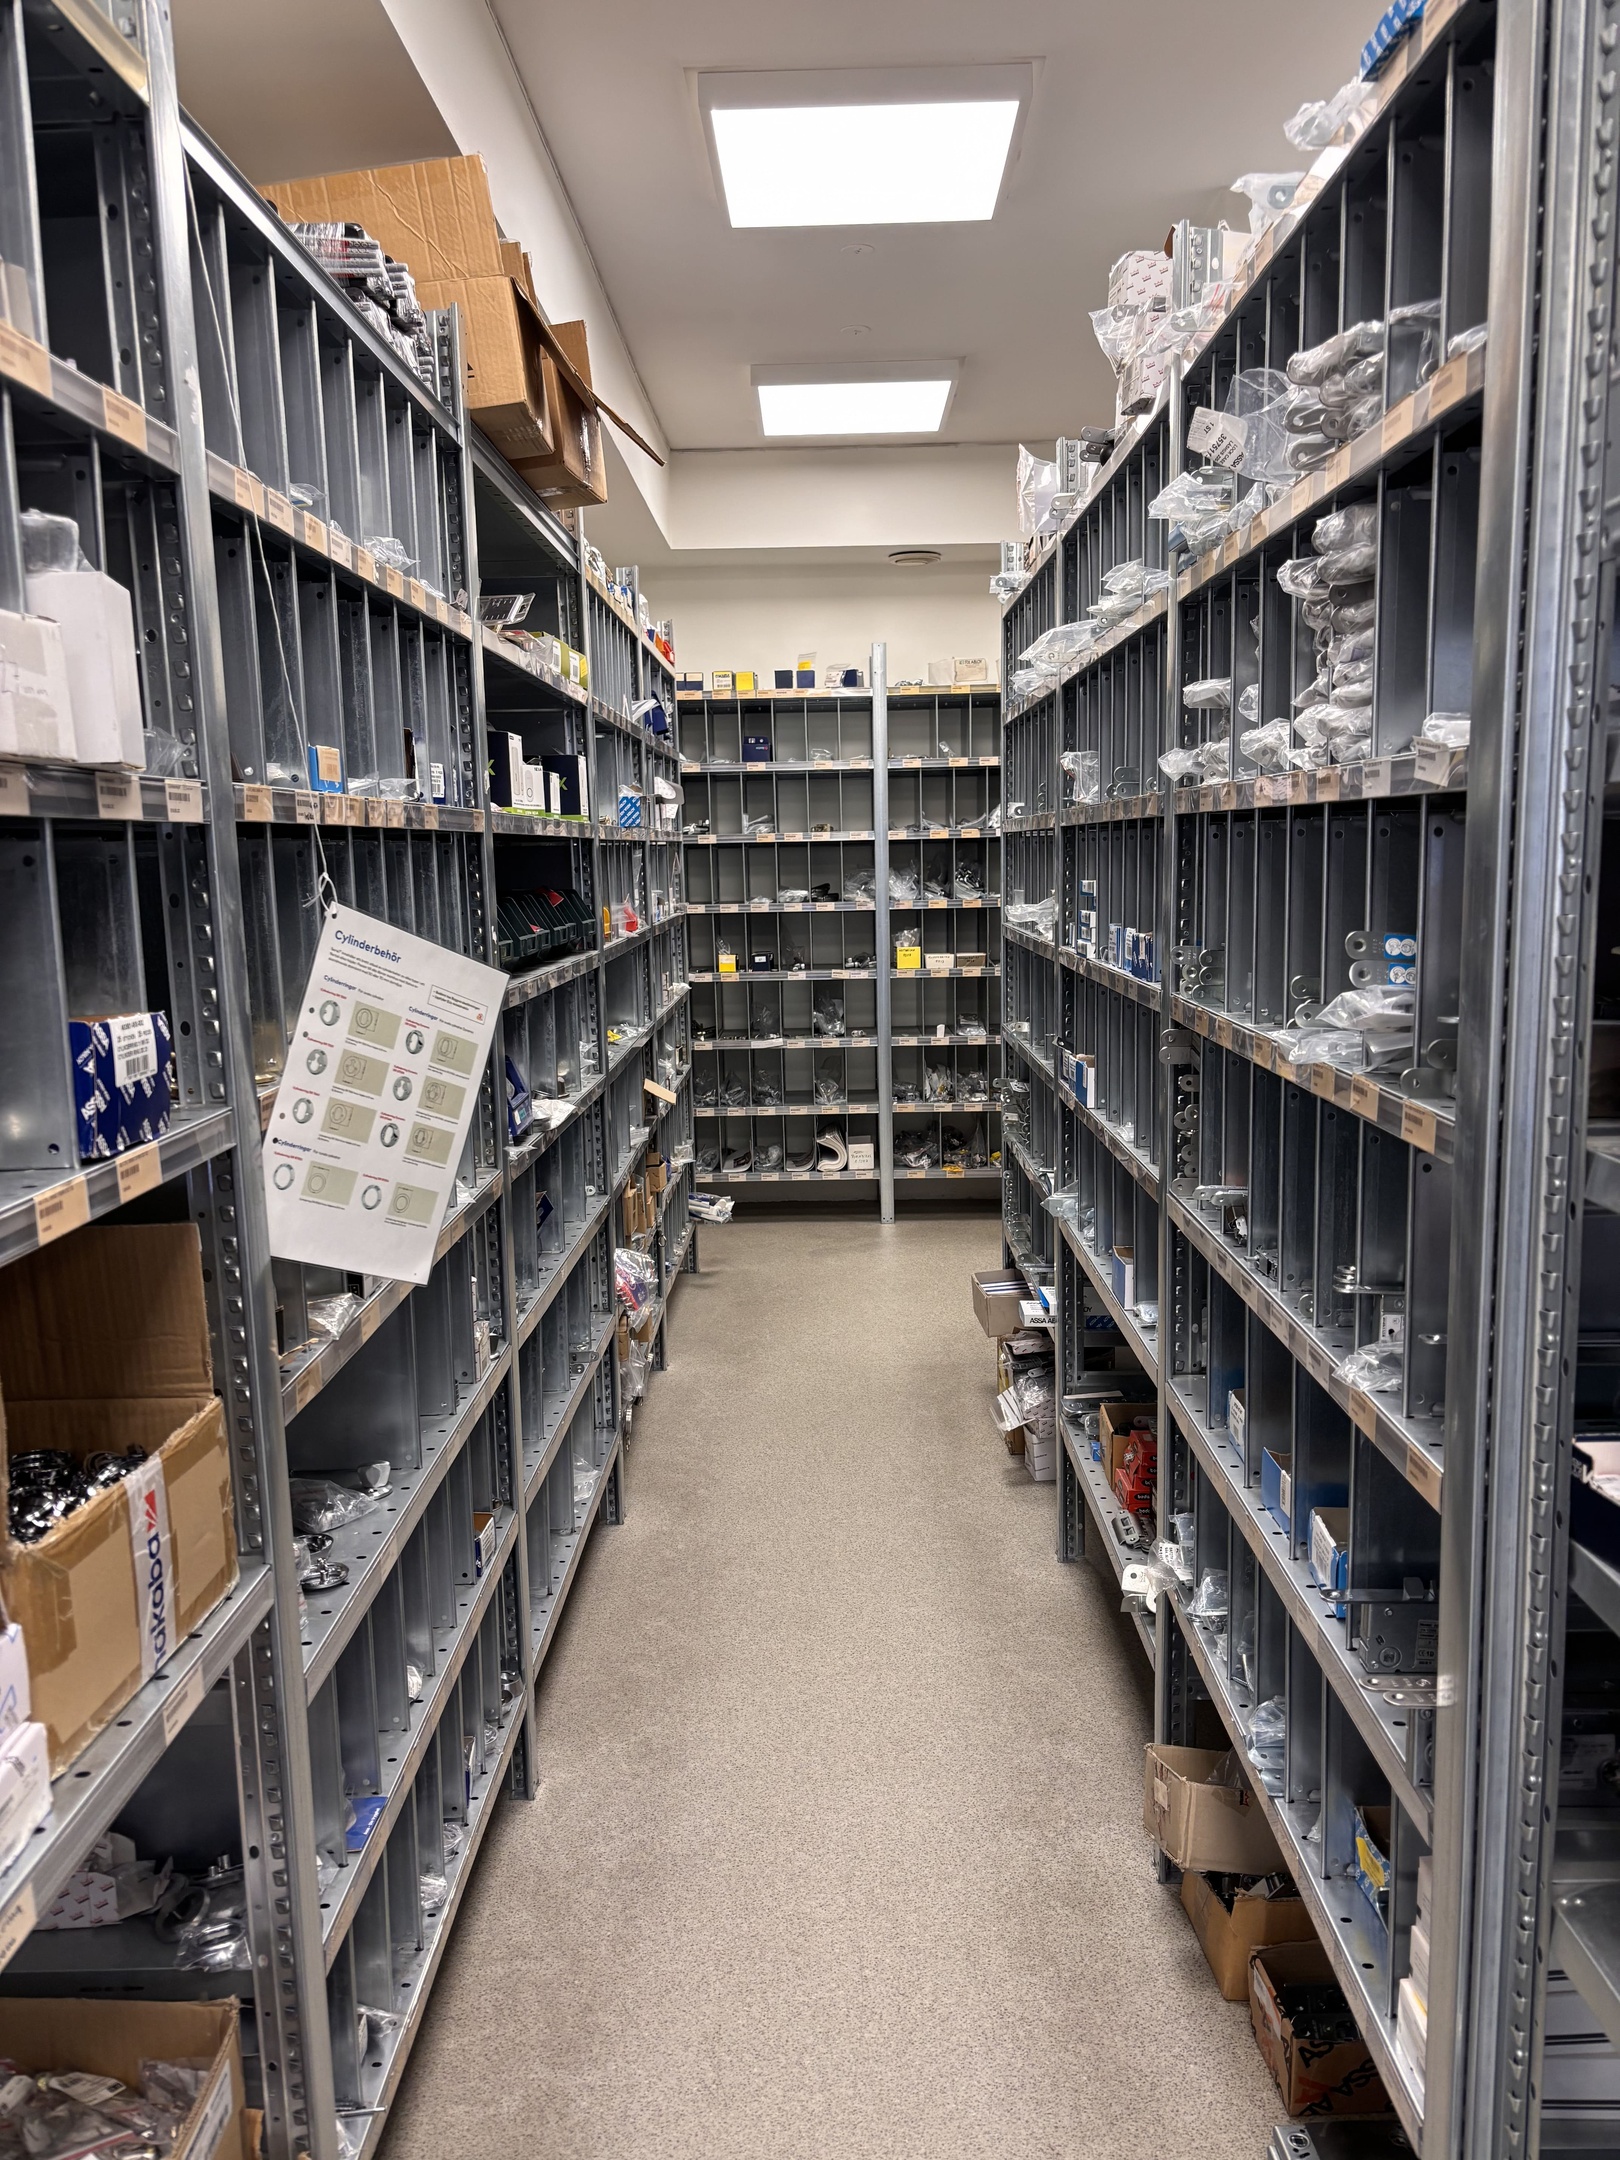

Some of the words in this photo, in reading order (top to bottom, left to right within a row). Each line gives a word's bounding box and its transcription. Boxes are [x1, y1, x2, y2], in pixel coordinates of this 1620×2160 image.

[1203, 425, 1211, 434] ST
[1228, 444, 1238, 455] LOCK
[1231, 452, 1245, 468] ASSA
[334, 930, 402, 963] Cylinderbehör
